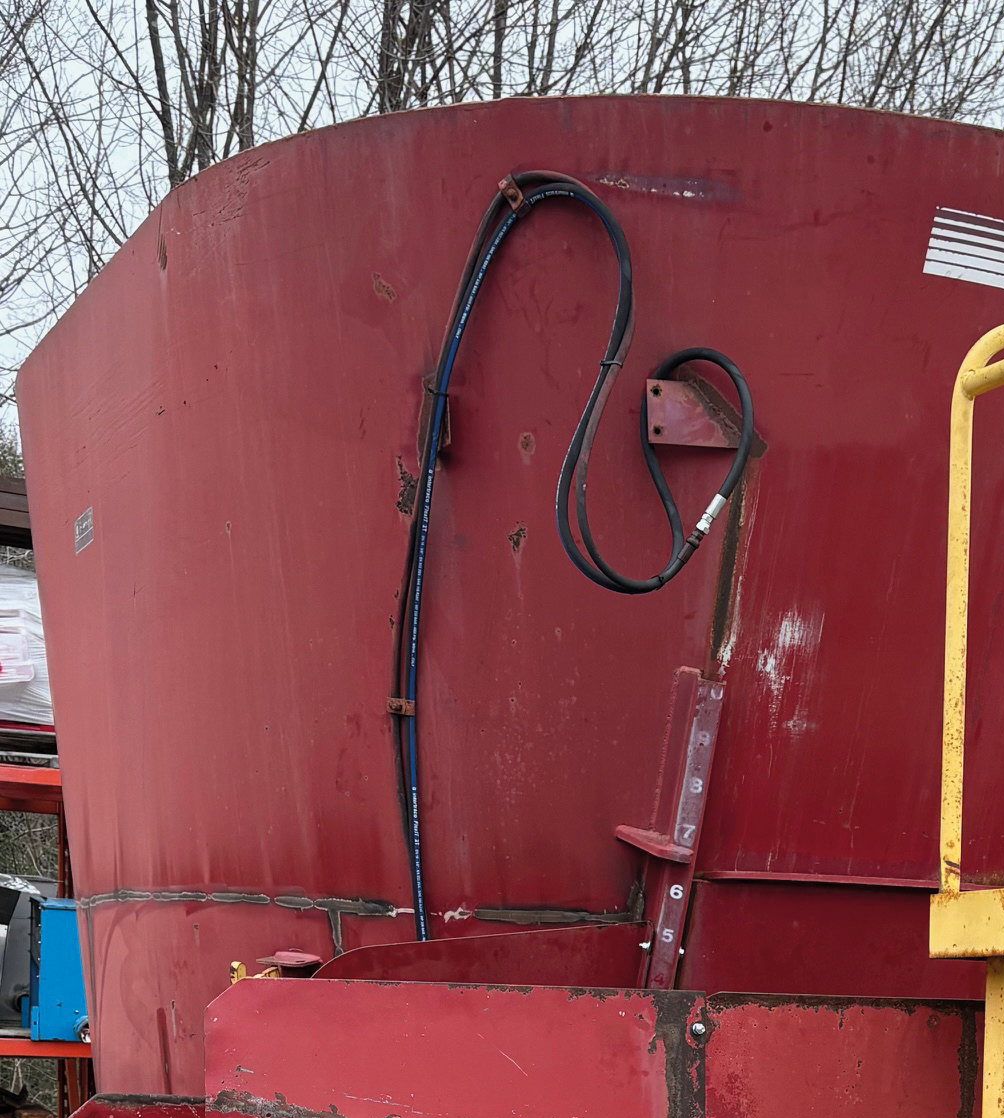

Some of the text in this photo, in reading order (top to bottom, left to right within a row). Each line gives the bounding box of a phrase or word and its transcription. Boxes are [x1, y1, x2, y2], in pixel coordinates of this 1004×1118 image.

[682, 824, 696, 839] 7
[669, 884, 684, 900] 6
[661, 929, 674, 943] 5
